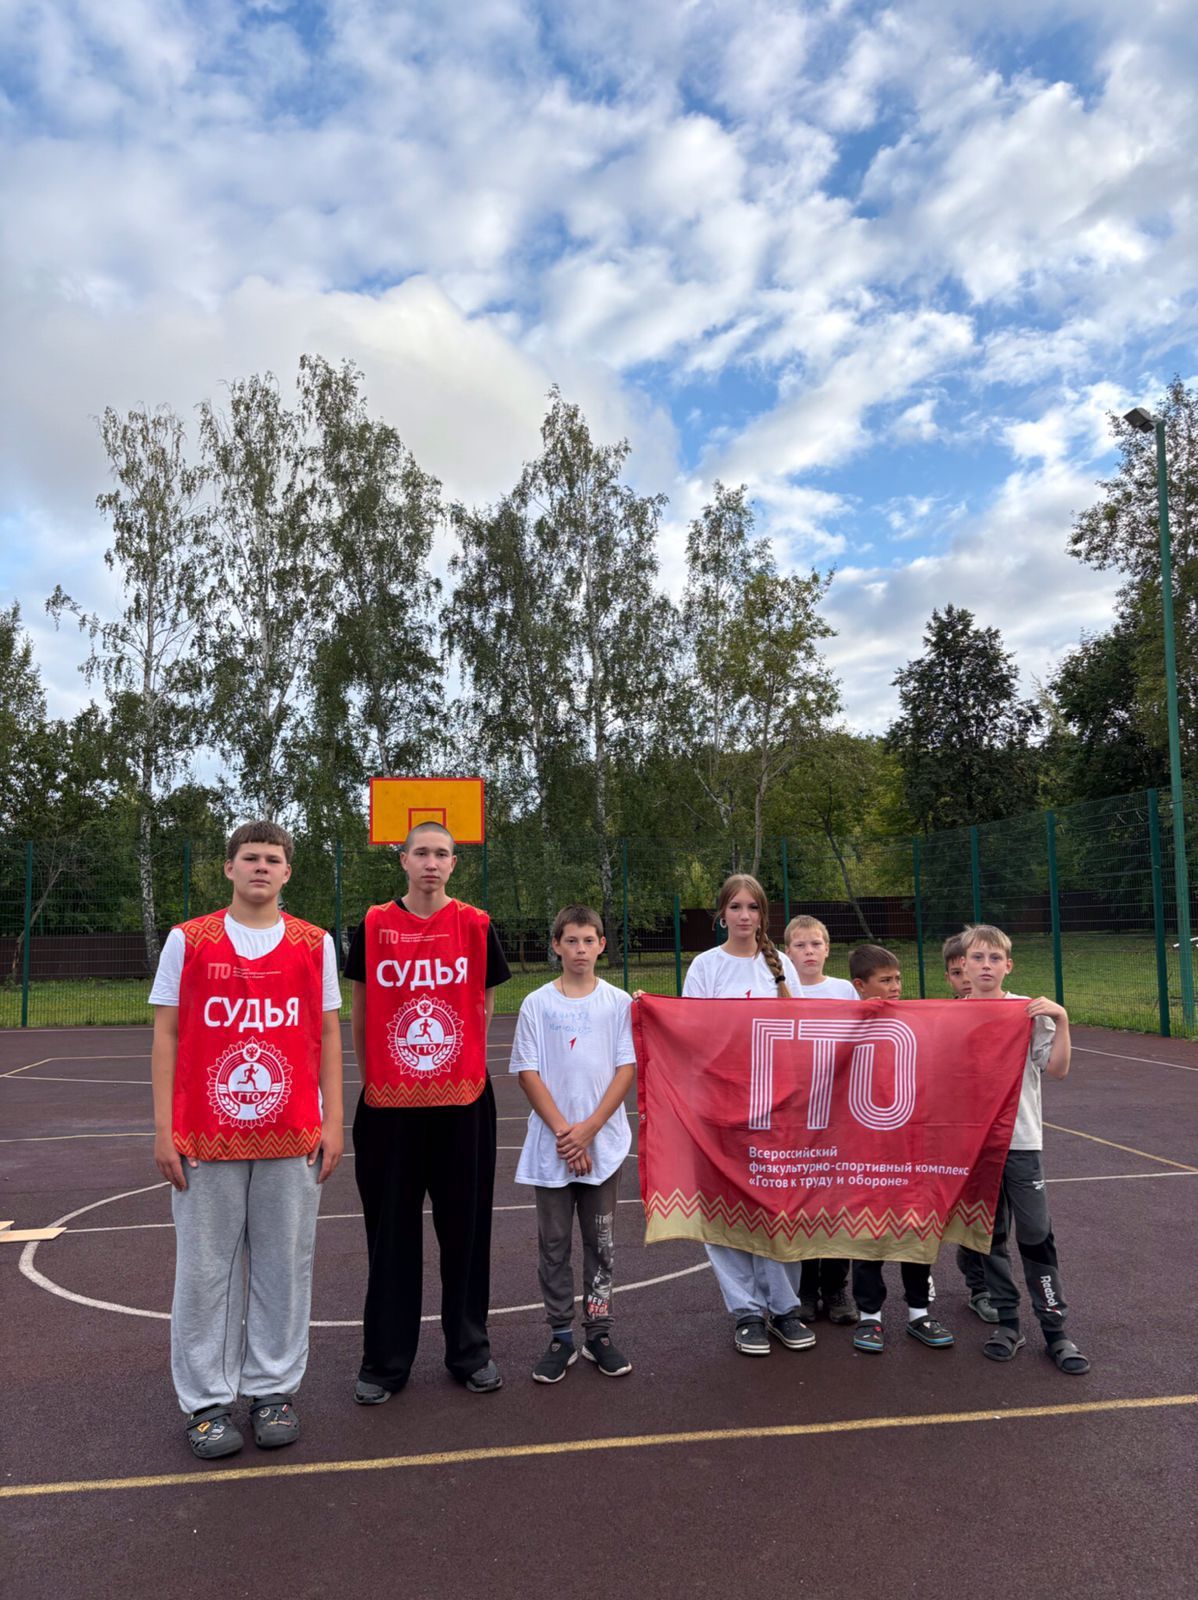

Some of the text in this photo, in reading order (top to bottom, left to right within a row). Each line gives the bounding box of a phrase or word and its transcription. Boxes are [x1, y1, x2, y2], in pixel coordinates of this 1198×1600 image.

[379, 929, 399, 944] ГТО
[208, 963, 231, 979] ГТО
[376, 956, 468, 991] СУДЬЯ
[204, 996, 299, 1033] СУДЬЯ
[416, 1044, 436, 1054] ГТО
[749, 1018, 917, 1131] ГТО
[238, 1092, 261, 1102] ГТО
[749, 1146, 837, 1162] Всероссийский
[749, 1160, 969, 1176] физкультурно-спортивный комплекс
[748, 1174, 909, 1189] «Готов к труду и обороне»
